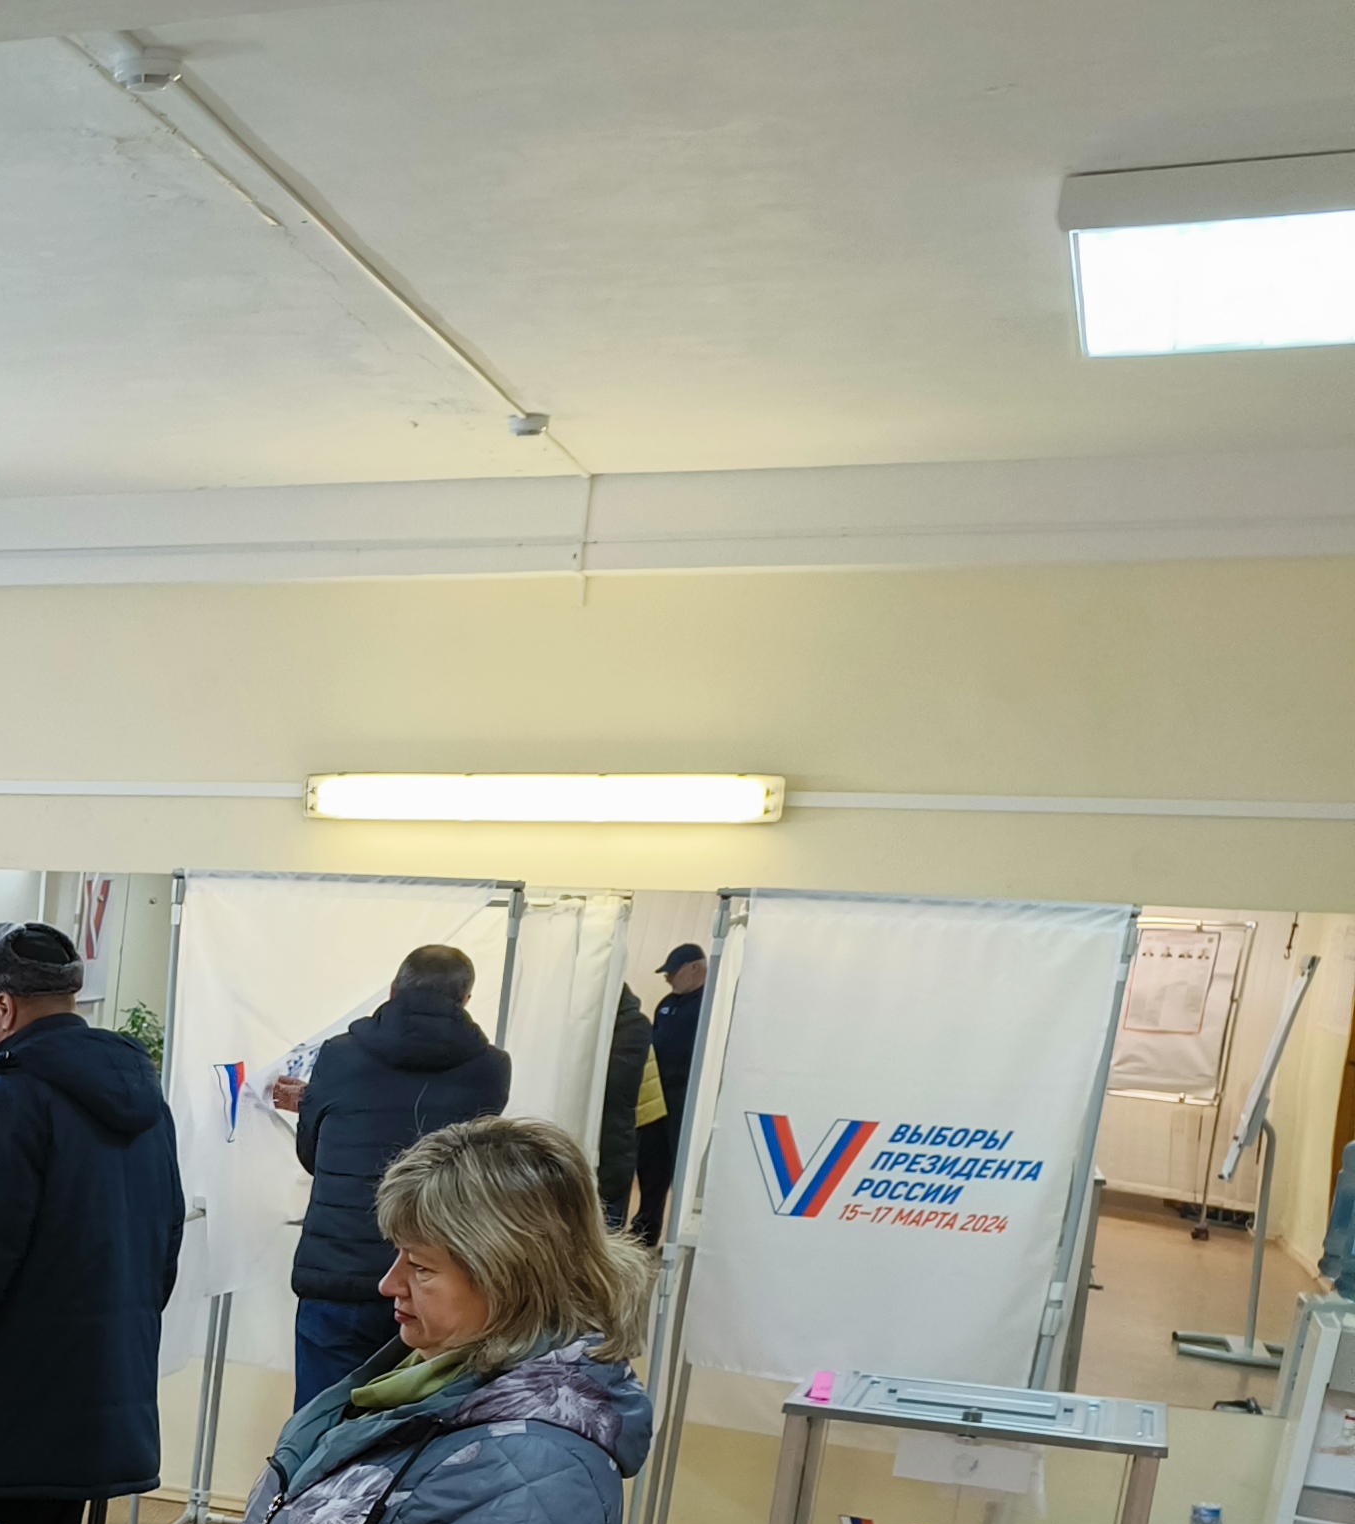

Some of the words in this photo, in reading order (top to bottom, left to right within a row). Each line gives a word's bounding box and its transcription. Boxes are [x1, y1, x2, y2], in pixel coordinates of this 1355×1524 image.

[888, 1123, 1014, 1151] ВЫБОРЫ
[870, 1151, 1044, 1181] ПРЕЗИДЕНТА
[851, 1178, 965, 1205] РОССИИ
[891, 1208, 961, 1230] МАРТА
[958, 1213, 1010, 1234] 2024
